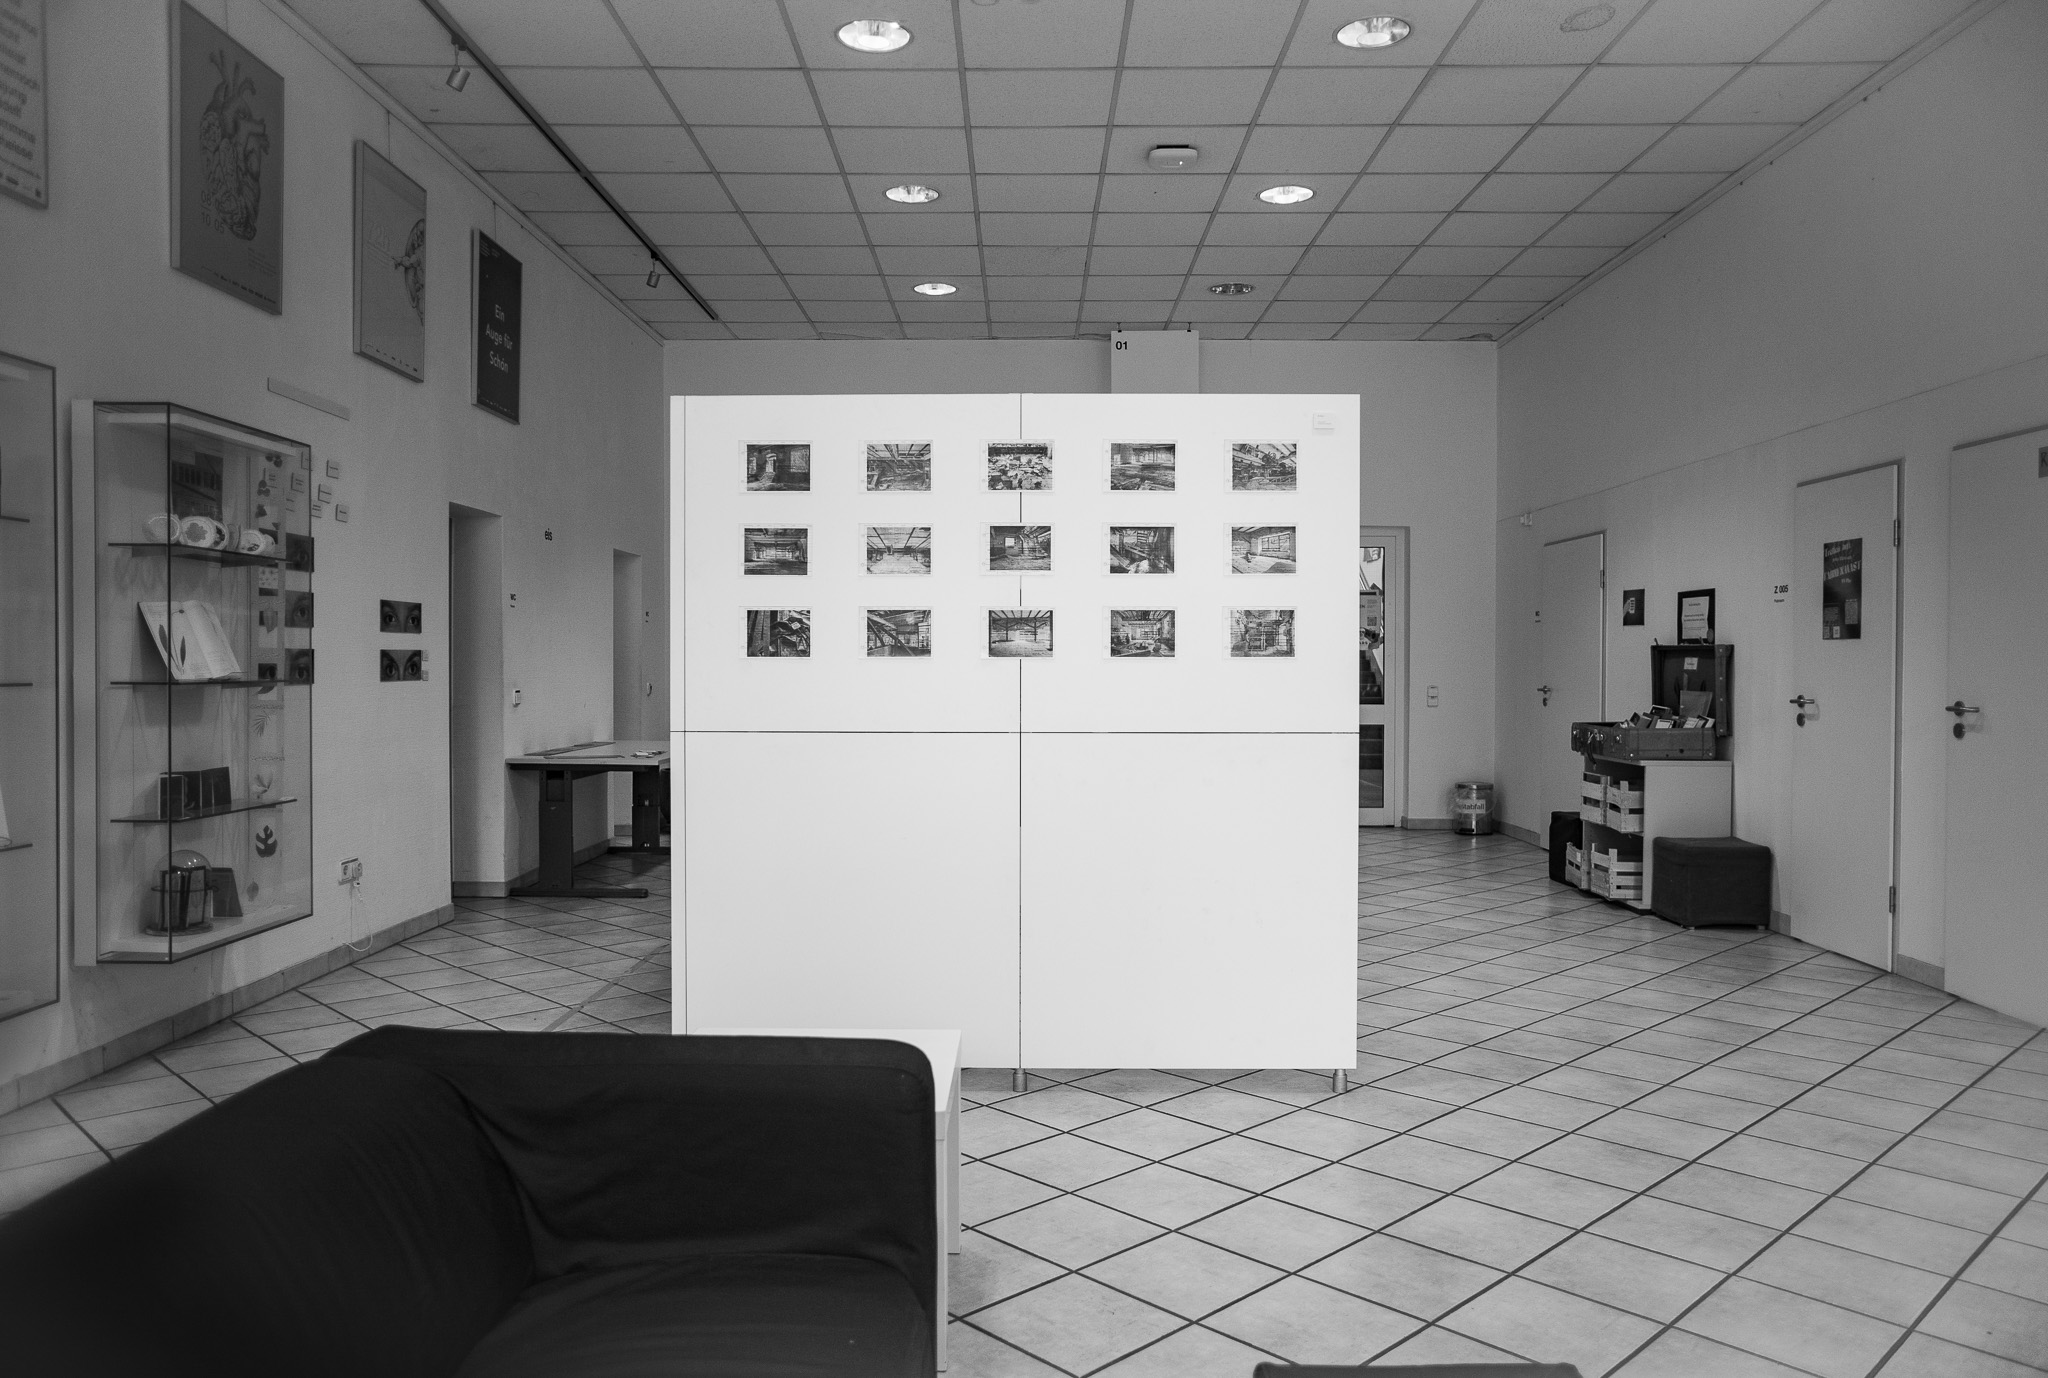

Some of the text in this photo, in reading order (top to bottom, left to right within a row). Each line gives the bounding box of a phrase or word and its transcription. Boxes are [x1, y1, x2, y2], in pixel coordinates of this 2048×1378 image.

[495, 304, 505, 322] Ein
[486, 323, 513, 350] Auge für
[1115, 340, 1128, 351] 01
